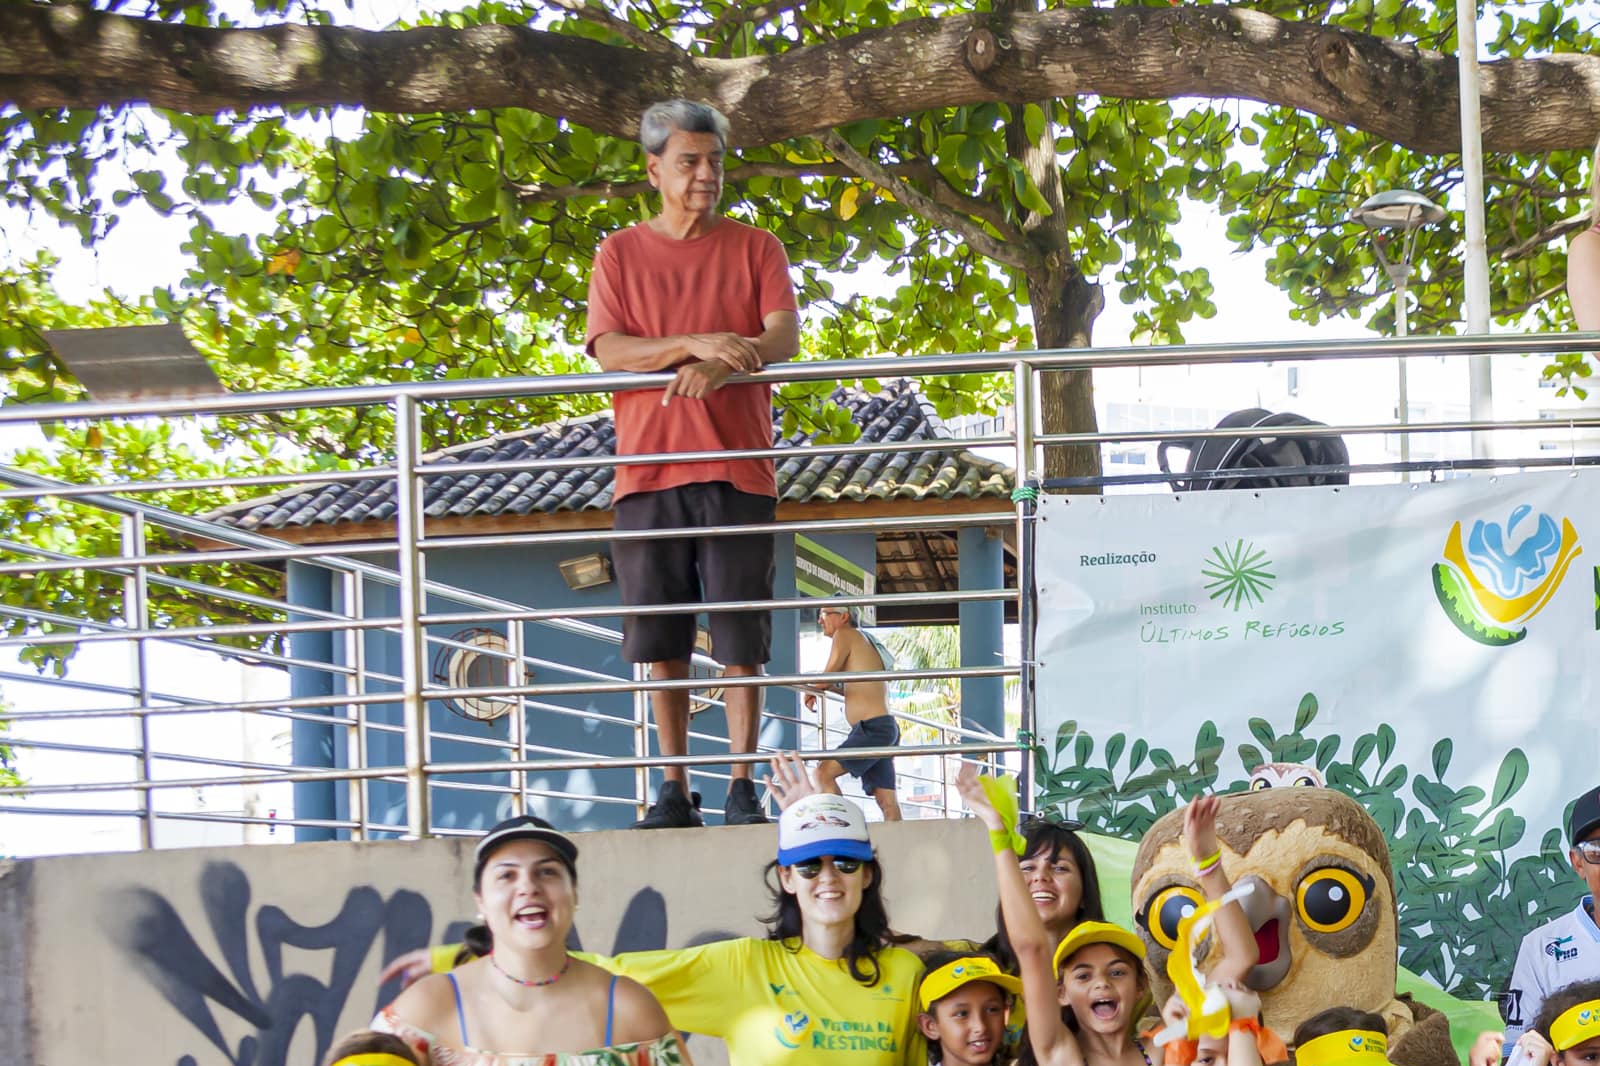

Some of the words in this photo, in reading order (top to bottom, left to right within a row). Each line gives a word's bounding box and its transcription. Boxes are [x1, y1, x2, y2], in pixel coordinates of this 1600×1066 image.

[1080, 551, 1157, 567] Realização
[1140, 603, 1197, 616] Instituto
[1140, 621, 1229, 643] ÚLTIMOS
[1244, 620, 1345, 640] REFÚGIOS
[812, 1031, 897, 1053] RESTINGA
